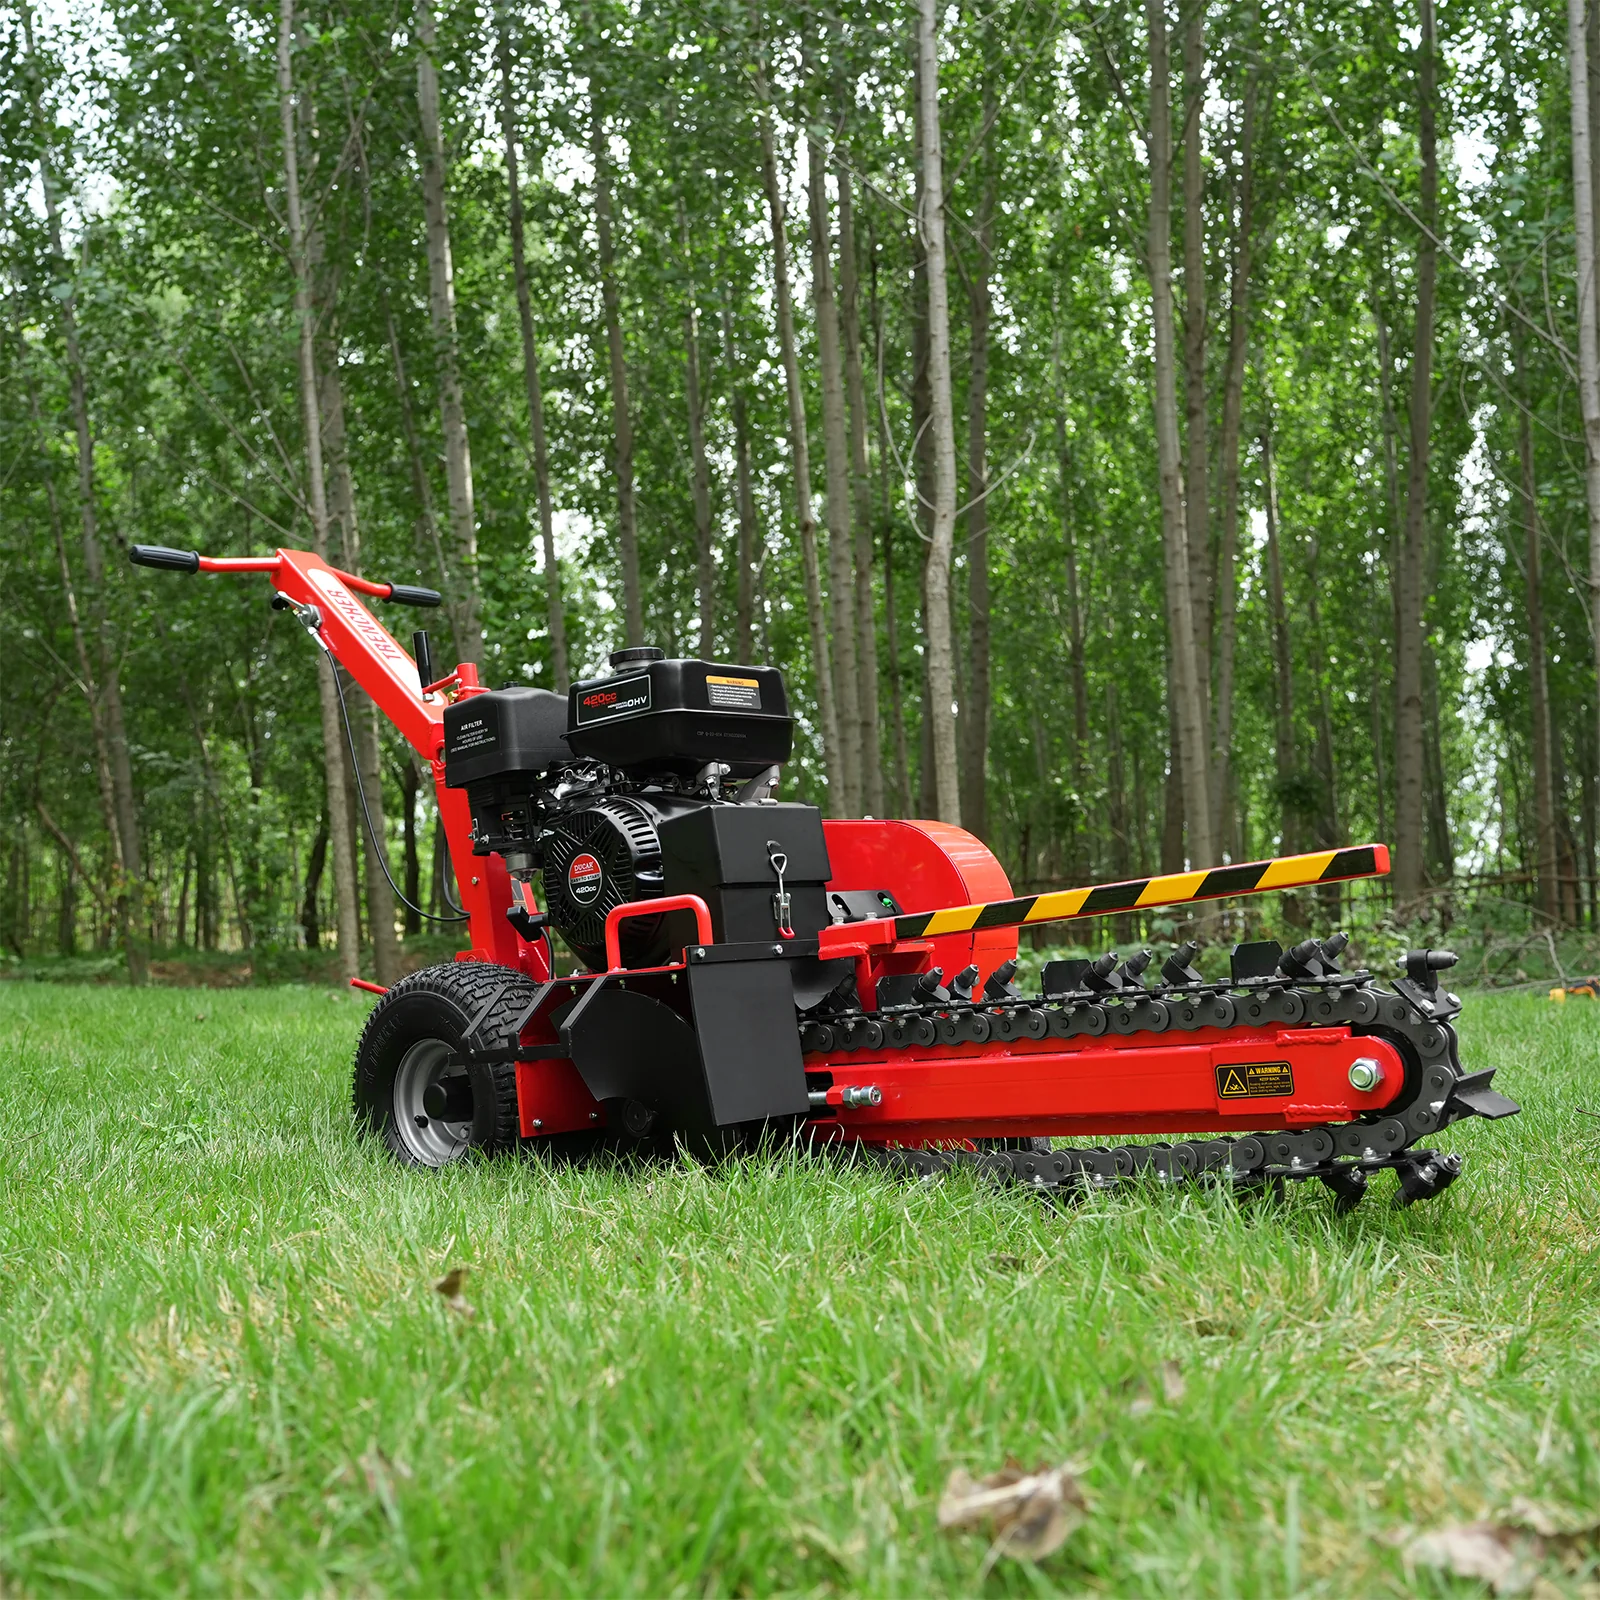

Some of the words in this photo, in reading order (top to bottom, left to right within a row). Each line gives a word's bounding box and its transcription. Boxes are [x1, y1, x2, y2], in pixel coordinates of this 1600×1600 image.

[327, 589, 402, 659] TRENCHER
[583, 692, 617, 706] 420cc
[627, 695, 647, 707] OHV
[468, 720, 483, 728] FILTER
[1255, 1066, 1281, 1074] WARNING
